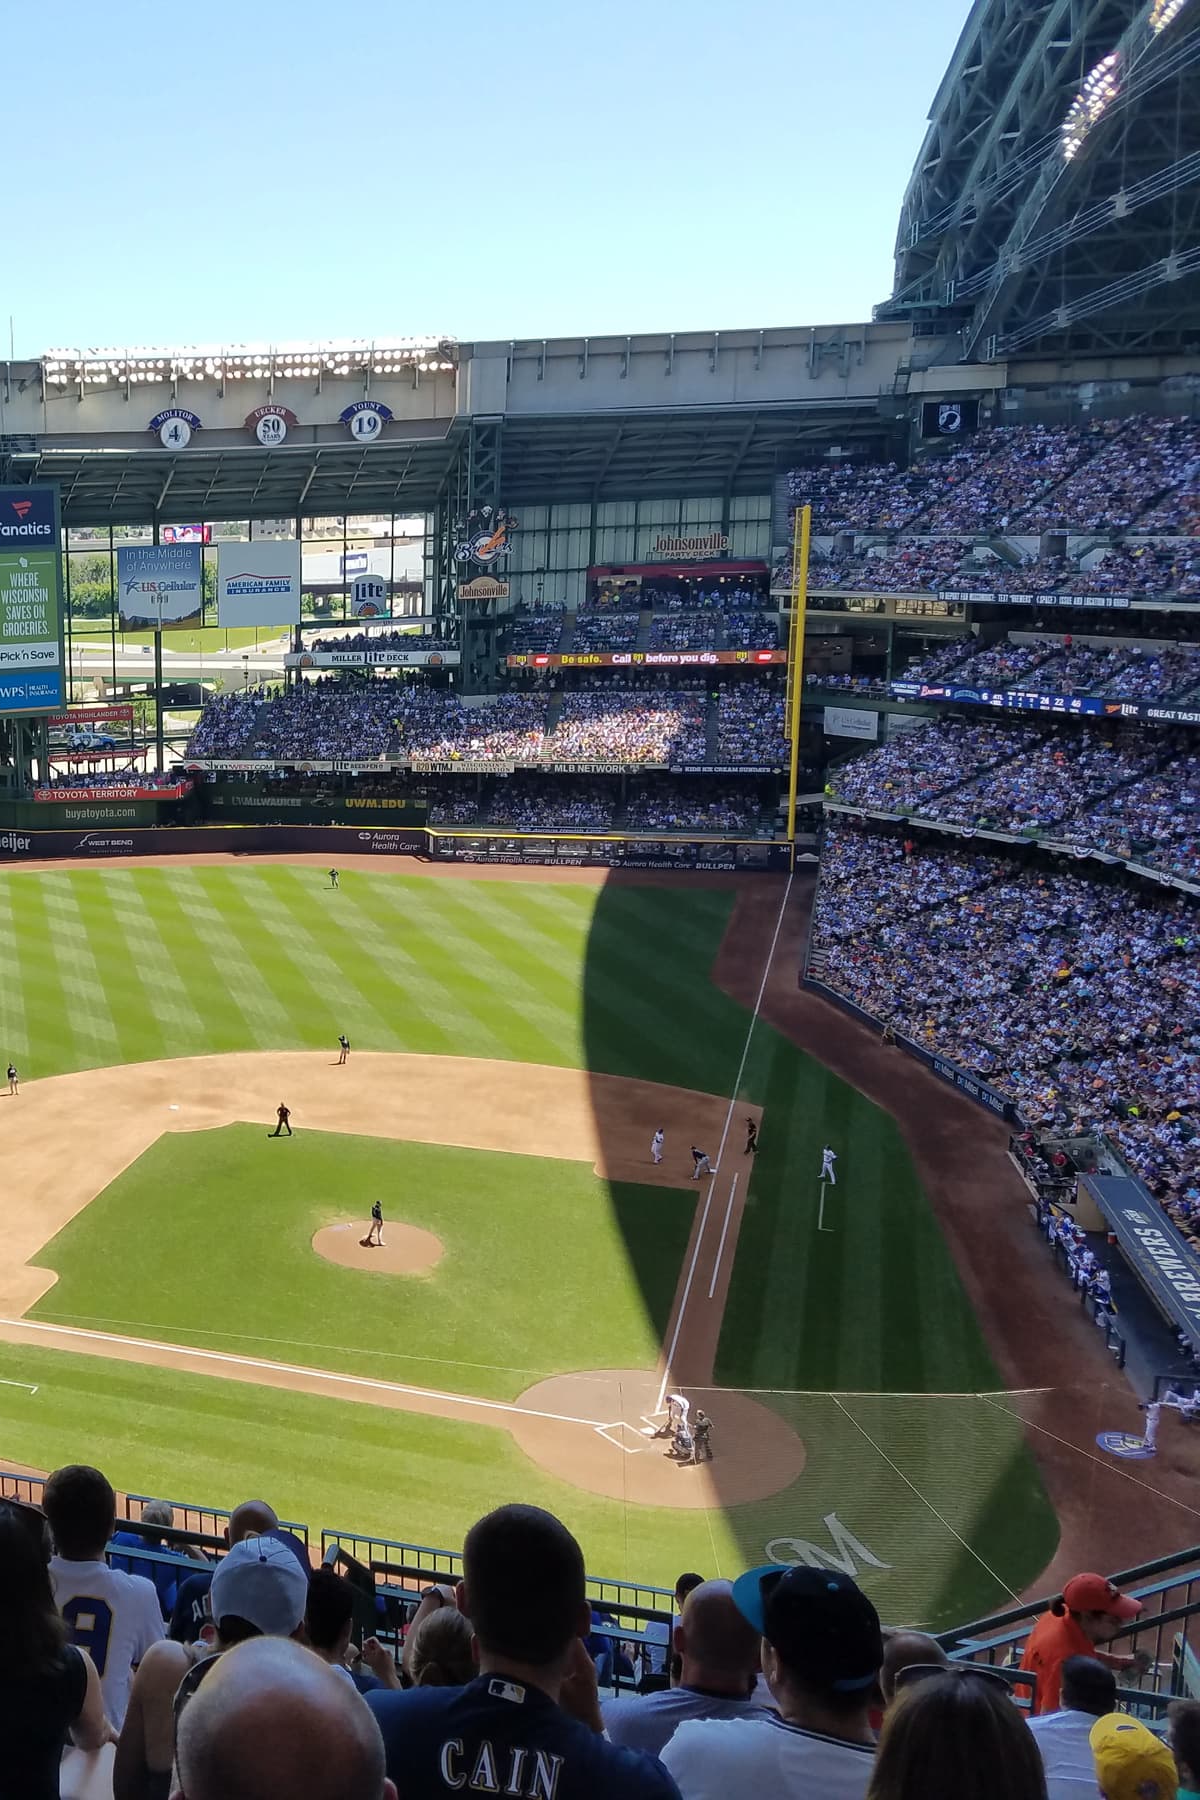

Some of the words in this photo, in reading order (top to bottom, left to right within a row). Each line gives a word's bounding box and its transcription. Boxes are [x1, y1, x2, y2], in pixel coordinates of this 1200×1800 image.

[254, 406, 287, 418] UECKER
[352, 402, 381, 412] YOUNT
[156, 410, 194, 423] MOLITOR
[262, 419, 281, 434] 50
[355, 416, 378, 434] 19
[168, 424, 181, 442] 4
[653, 532, 728, 552] Johnsonville
[126, 549, 136, 559] In
[138, 548, 155, 559] the
[157, 548, 192, 559] Middle
[126, 561, 138, 572] of
[139, 560, 191, 572] Anywhere
[9, 572, 40, 587] WHERE
[265, 579, 291, 587] FAMILY
[158, 580, 197, 592] Cellular
[460, 586, 508, 598] Johnsonville
[0, 588, 49, 604] WISCONSIN
[355, 583, 384, 602] Lite
[6, 605, 32, 620] SAVES
[33, 604, 46, 619] ON
[2, 620, 50, 637] GROCERIES.
[0, 652, 20, 662] Pick
[30, 650, 55, 660] Save
[363, 652, 385, 666] Lite
[386, 654, 409, 662] DECK
[561, 656, 575, 664] Be
[612, 653, 631, 663] Call
[632, 653, 644, 662] 811
[645, 653, 678, 663] before
[680, 654, 699, 664] you
[700, 653, 719, 664] dig.
[736, 651, 748, 660] 811
[0, 686, 25, 698] WPS
[78, 711, 118, 719] HIGHLANDER
[1121, 703, 1140, 716] Lite
[1147, 709, 1176, 719] GREAT
[416, 762, 430, 771] 620
[431, 762, 452, 772] WTMJ
[554, 764, 575, 773] MLB
[578, 764, 626, 773] NETWORK
[53, 791, 88, 799] TOYOTA
[91, 789, 138, 798] TERRITORY
[345, 798, 406, 809] UWM.EDU
[65, 807, 136, 820] buyatoyota.com
[372, 832, 400, 841] Aurora
[371, 841, 398, 850] Health
[400, 842, 418, 850] Care
[476, 855, 500, 863] Aurora
[501, 856, 523, 864] Health
[524, 857, 540, 865] Care
[544, 858, 583, 866] BULLPEN
[622, 860, 647, 868] Aurora
[648, 860, 673, 869] Health
[674, 861, 690, 869] Care
[695, 862, 736, 870] BULLPEN
[1133, 1228, 1200, 1302] BREWERS
[440, 1737, 565, 1800] CAIN
